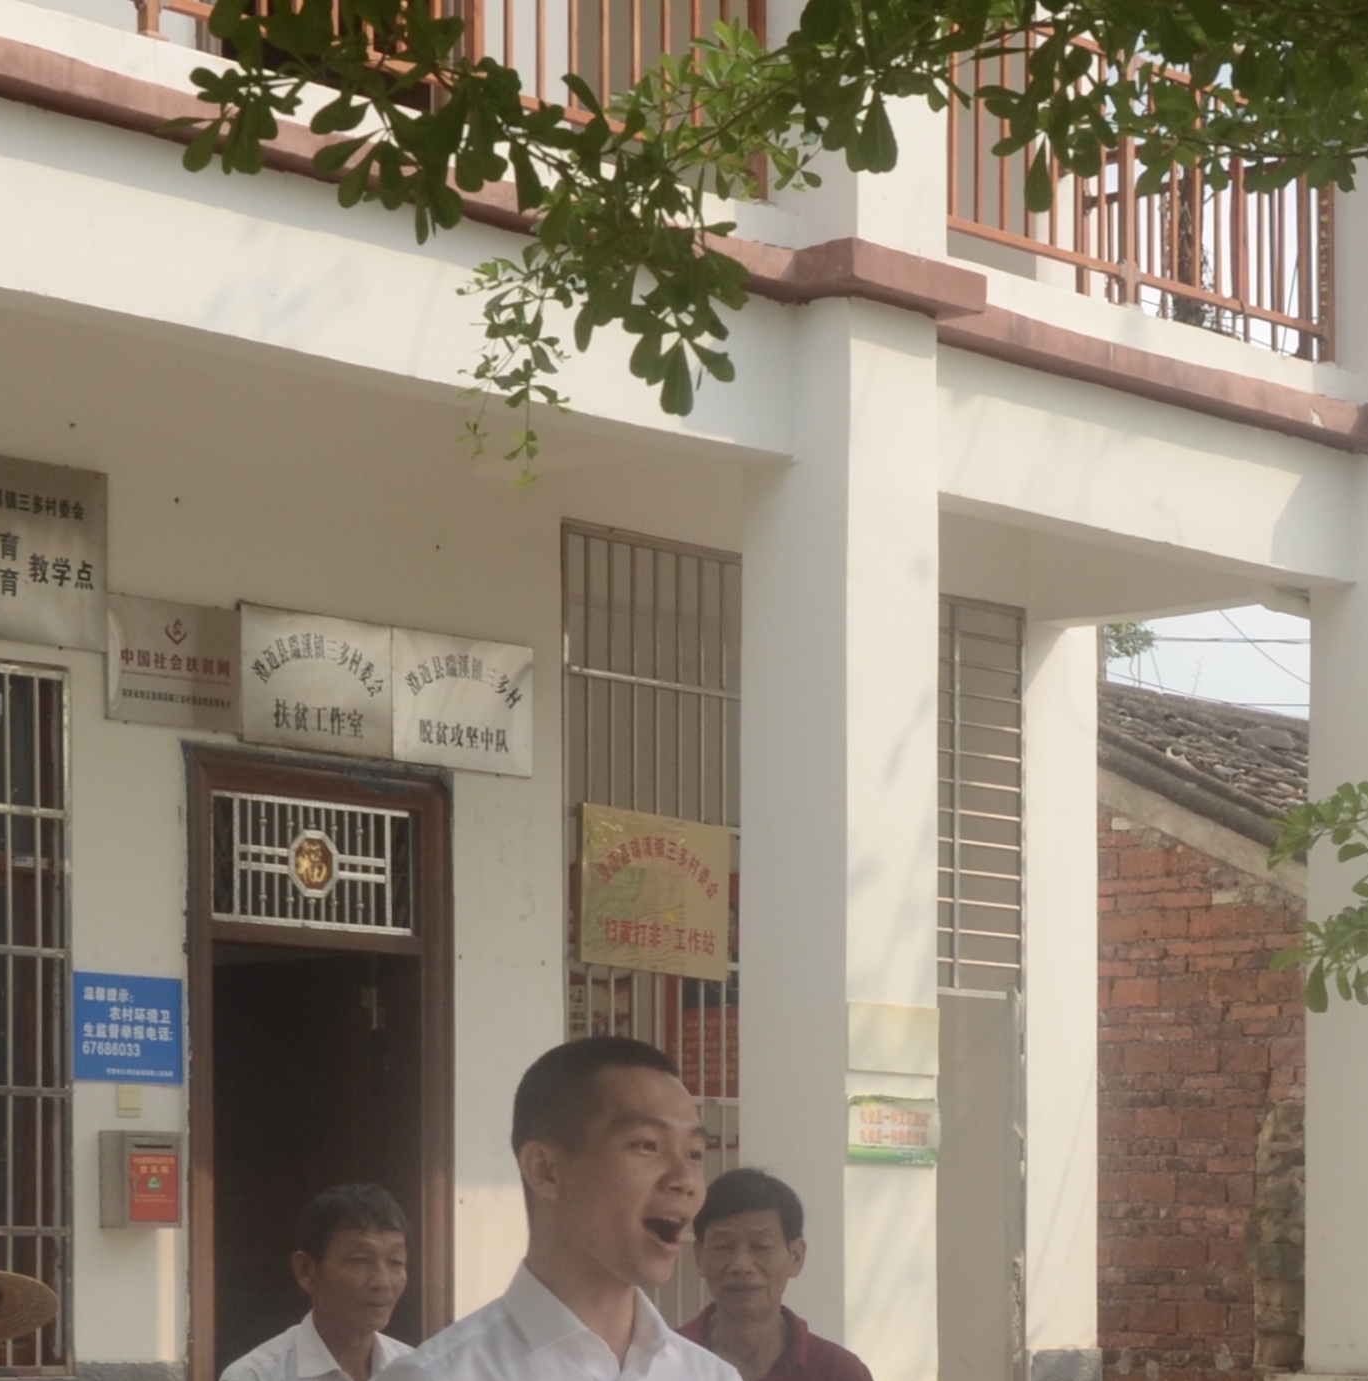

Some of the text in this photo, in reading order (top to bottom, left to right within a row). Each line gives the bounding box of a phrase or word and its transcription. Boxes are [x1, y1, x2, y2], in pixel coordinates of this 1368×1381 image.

[29, 553, 94, 590] 教学点
[120, 648, 231, 678] 中国社会扶贫网
[251, 632, 384, 697] 澄迈县瑞溪镇三多村委会
[404, 654, 523, 709] 澄迈县瑞溪镇三多村
[273, 698, 364, 739] 扶贫工作室
[419, 719, 509, 753] 脱贫攻坚中队
[109, 1006, 171, 1024] 农村环境卫
